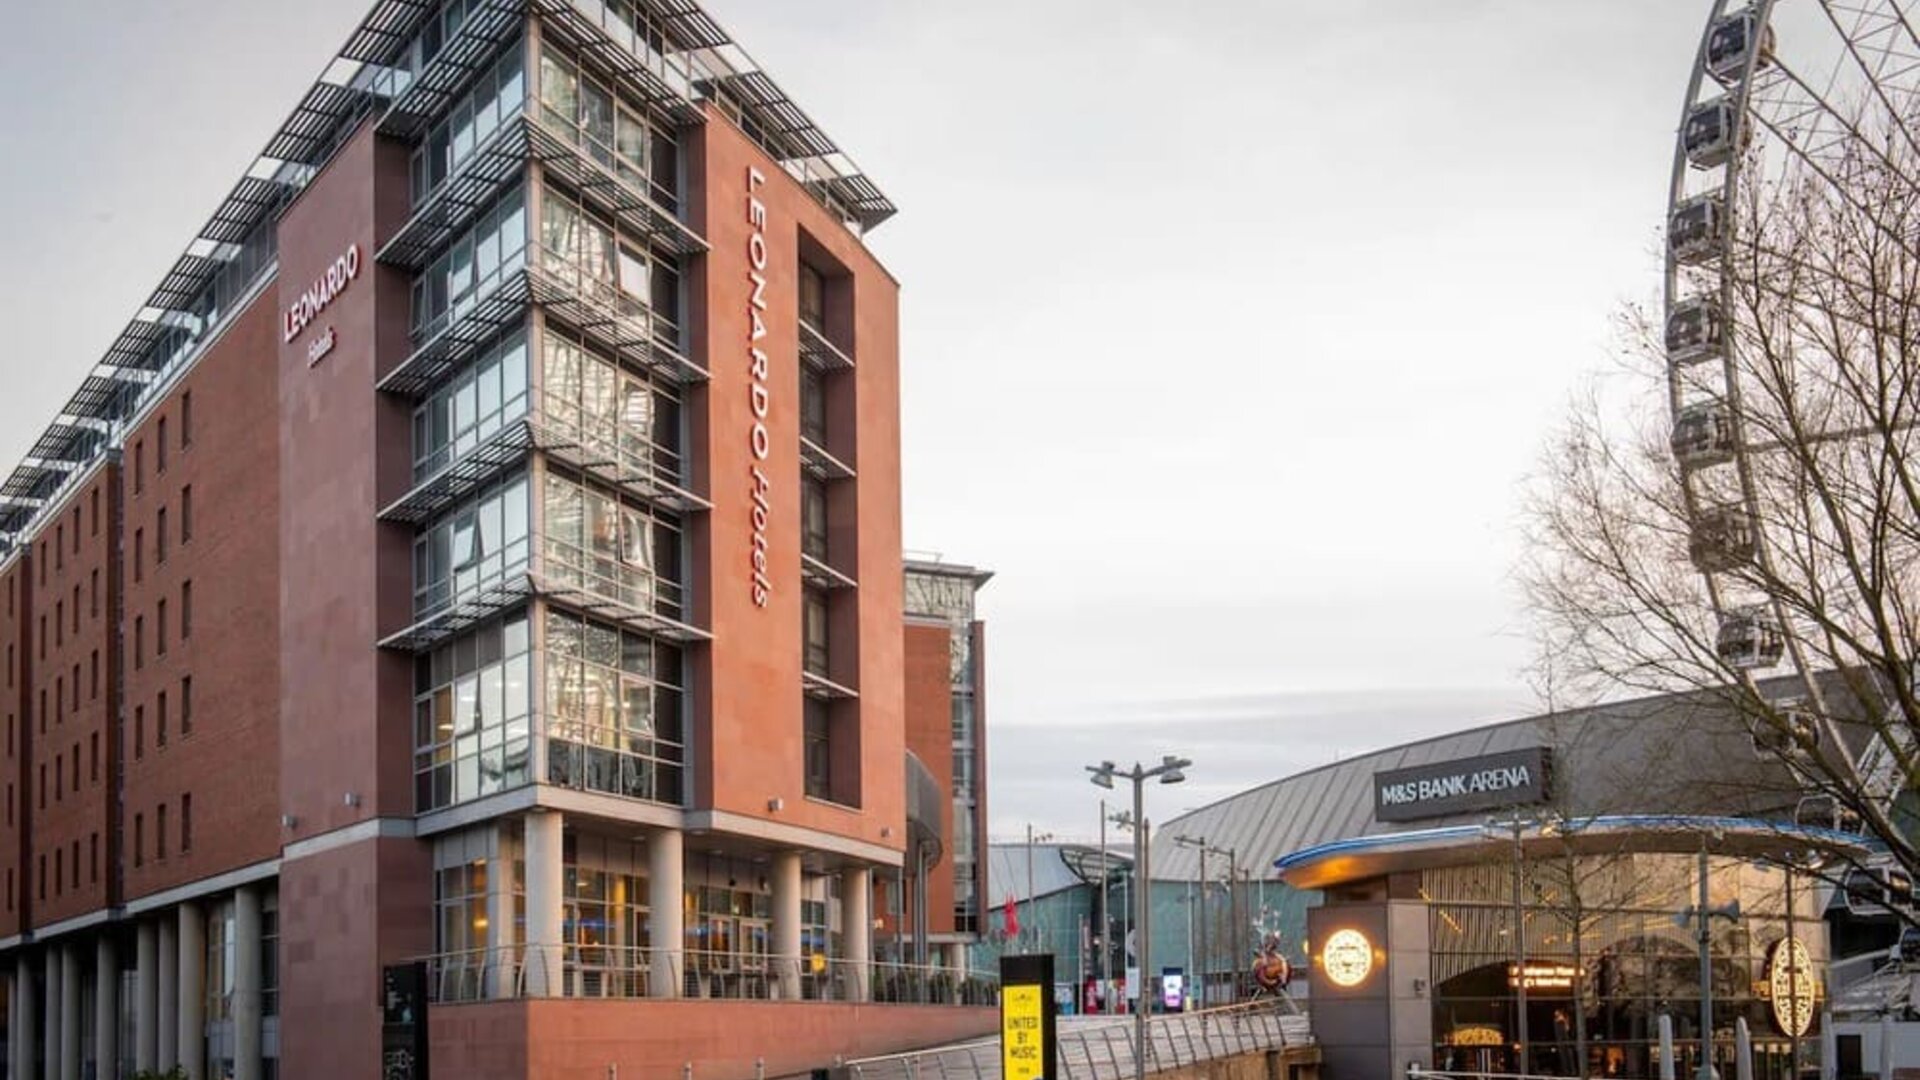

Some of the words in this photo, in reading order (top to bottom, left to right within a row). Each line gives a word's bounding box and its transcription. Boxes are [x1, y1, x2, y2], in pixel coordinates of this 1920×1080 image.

[284, 243, 359, 342] LEONARDO
[749, 165, 768, 461] LEONARDO
[752, 466, 771, 608] Hotels
[1382, 783, 1417, 805] M&S
[1419, 774, 1467, 800] BANK
[1470, 766, 1530, 792] ARENA
[1007, 1016, 1038, 1029] UNITED
[1017, 1031, 1028, 1044] BY
[1010, 1046, 1036, 1060] MUSIC
